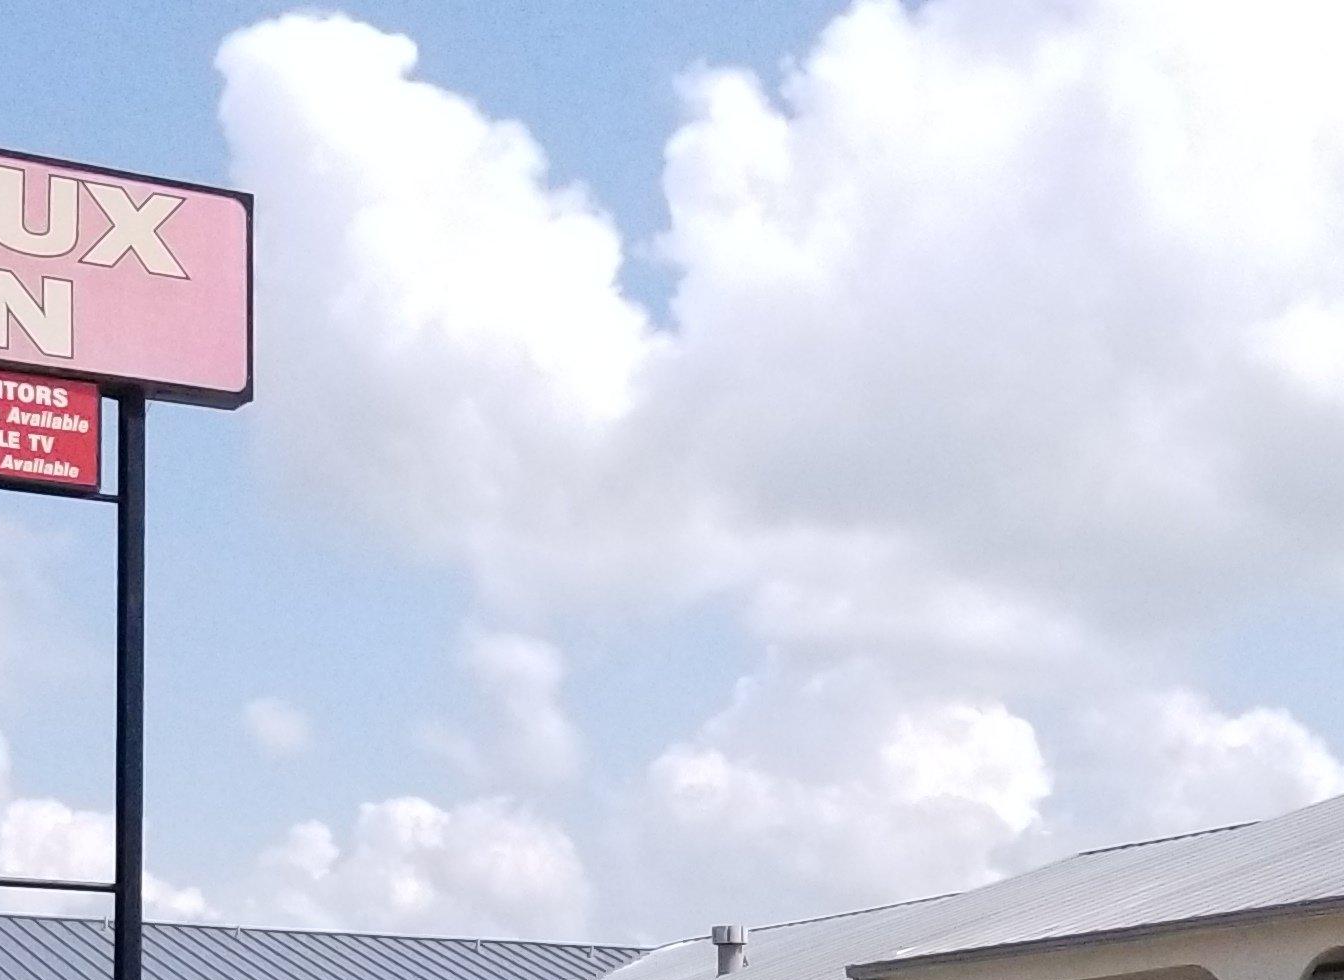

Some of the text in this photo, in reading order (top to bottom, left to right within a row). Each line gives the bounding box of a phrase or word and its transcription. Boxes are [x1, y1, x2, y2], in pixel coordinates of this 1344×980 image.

[6, 407, 89, 433] Available
[27, 434, 55, 453] TV
[1, 454, 80, 479] Available
